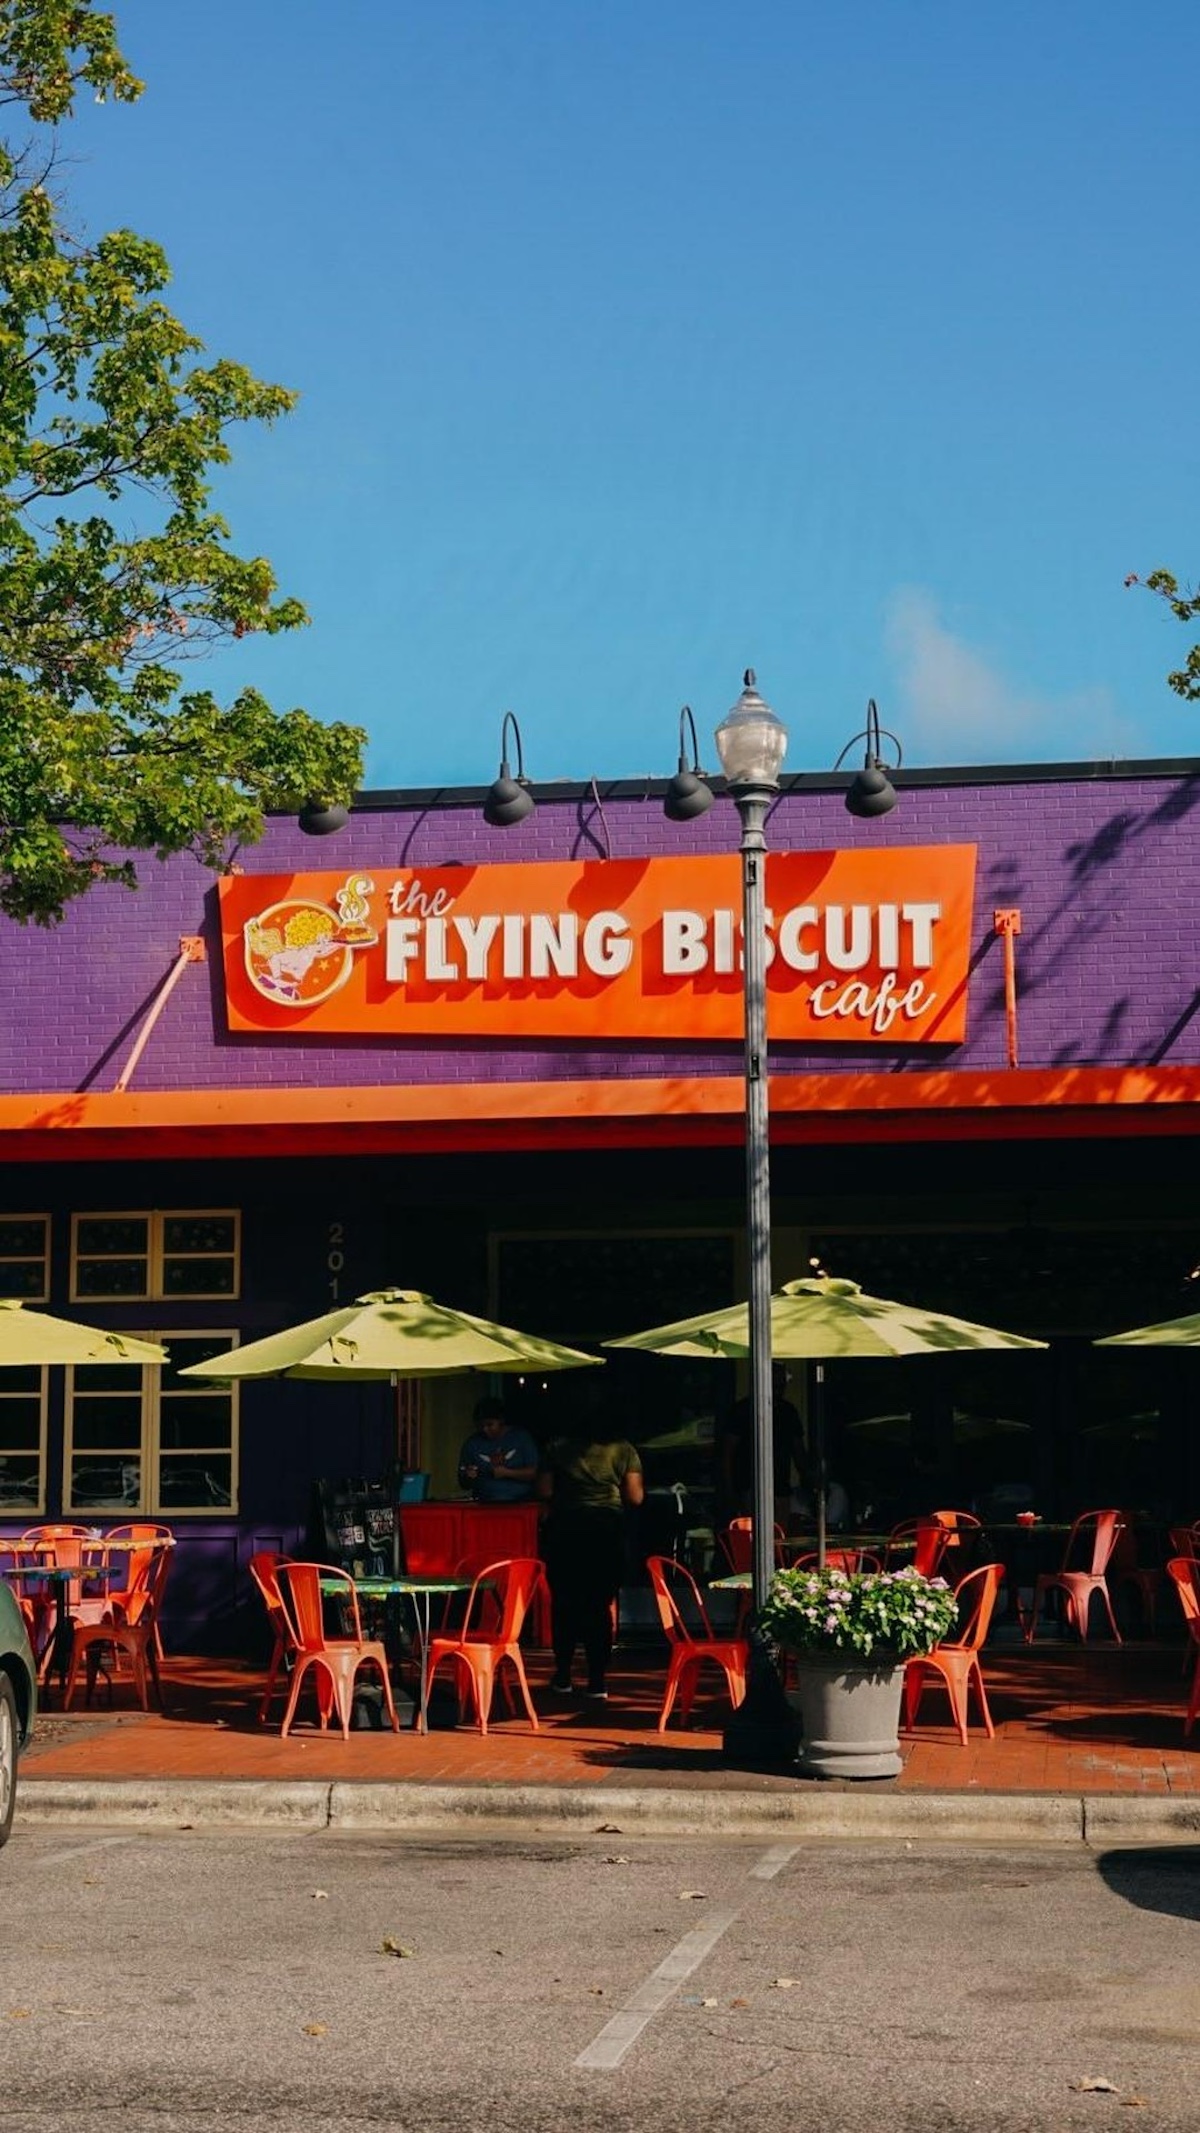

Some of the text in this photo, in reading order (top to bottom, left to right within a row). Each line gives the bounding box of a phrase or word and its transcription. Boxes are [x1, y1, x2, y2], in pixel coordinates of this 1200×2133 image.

[388, 879, 455, 917] the
[386, 911, 633, 982] FLYING
[810, 972, 937, 1032] cafe
[327, 1222, 344, 1312] 201
